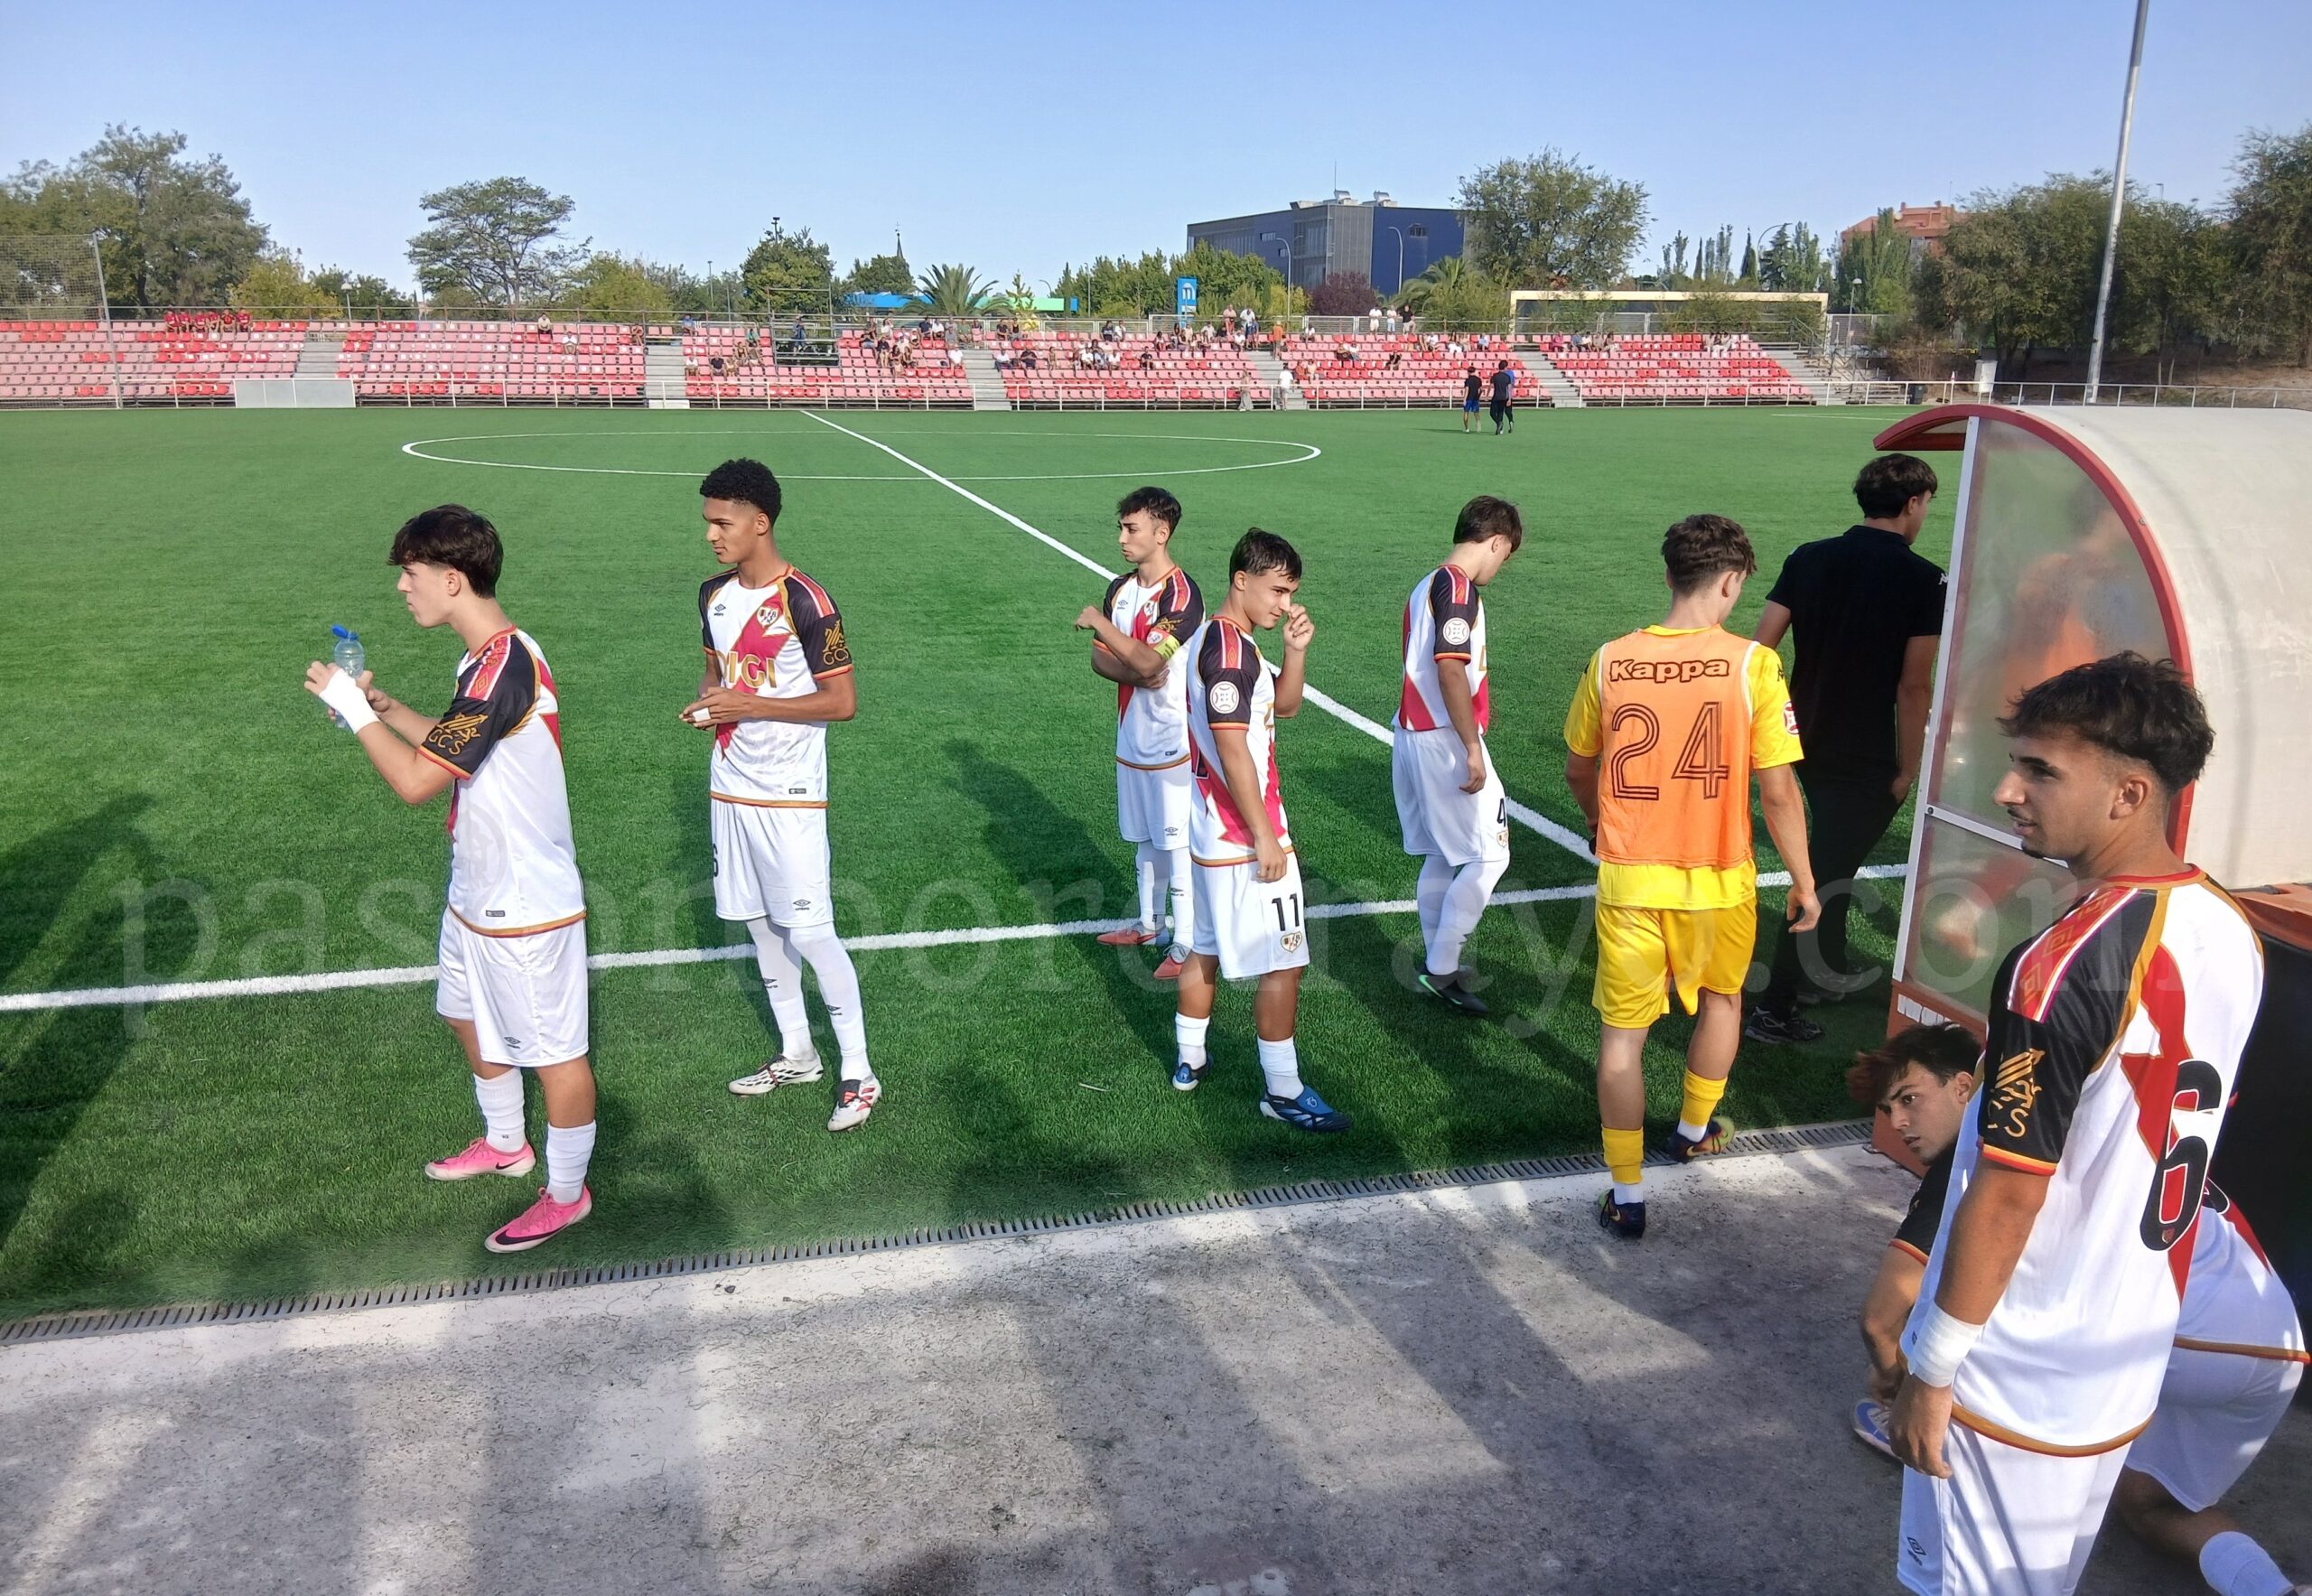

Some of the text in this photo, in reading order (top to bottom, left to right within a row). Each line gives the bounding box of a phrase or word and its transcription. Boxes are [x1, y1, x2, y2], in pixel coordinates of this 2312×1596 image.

[1609, 658, 1729, 684] Kappa
[428, 729, 465, 755] GCS
[1611, 701, 1729, 801] 24
[1496, 798, 1507, 827] 4
[1271, 892, 1300, 932] 11
[2140, 1058, 2223, 1251] 6
